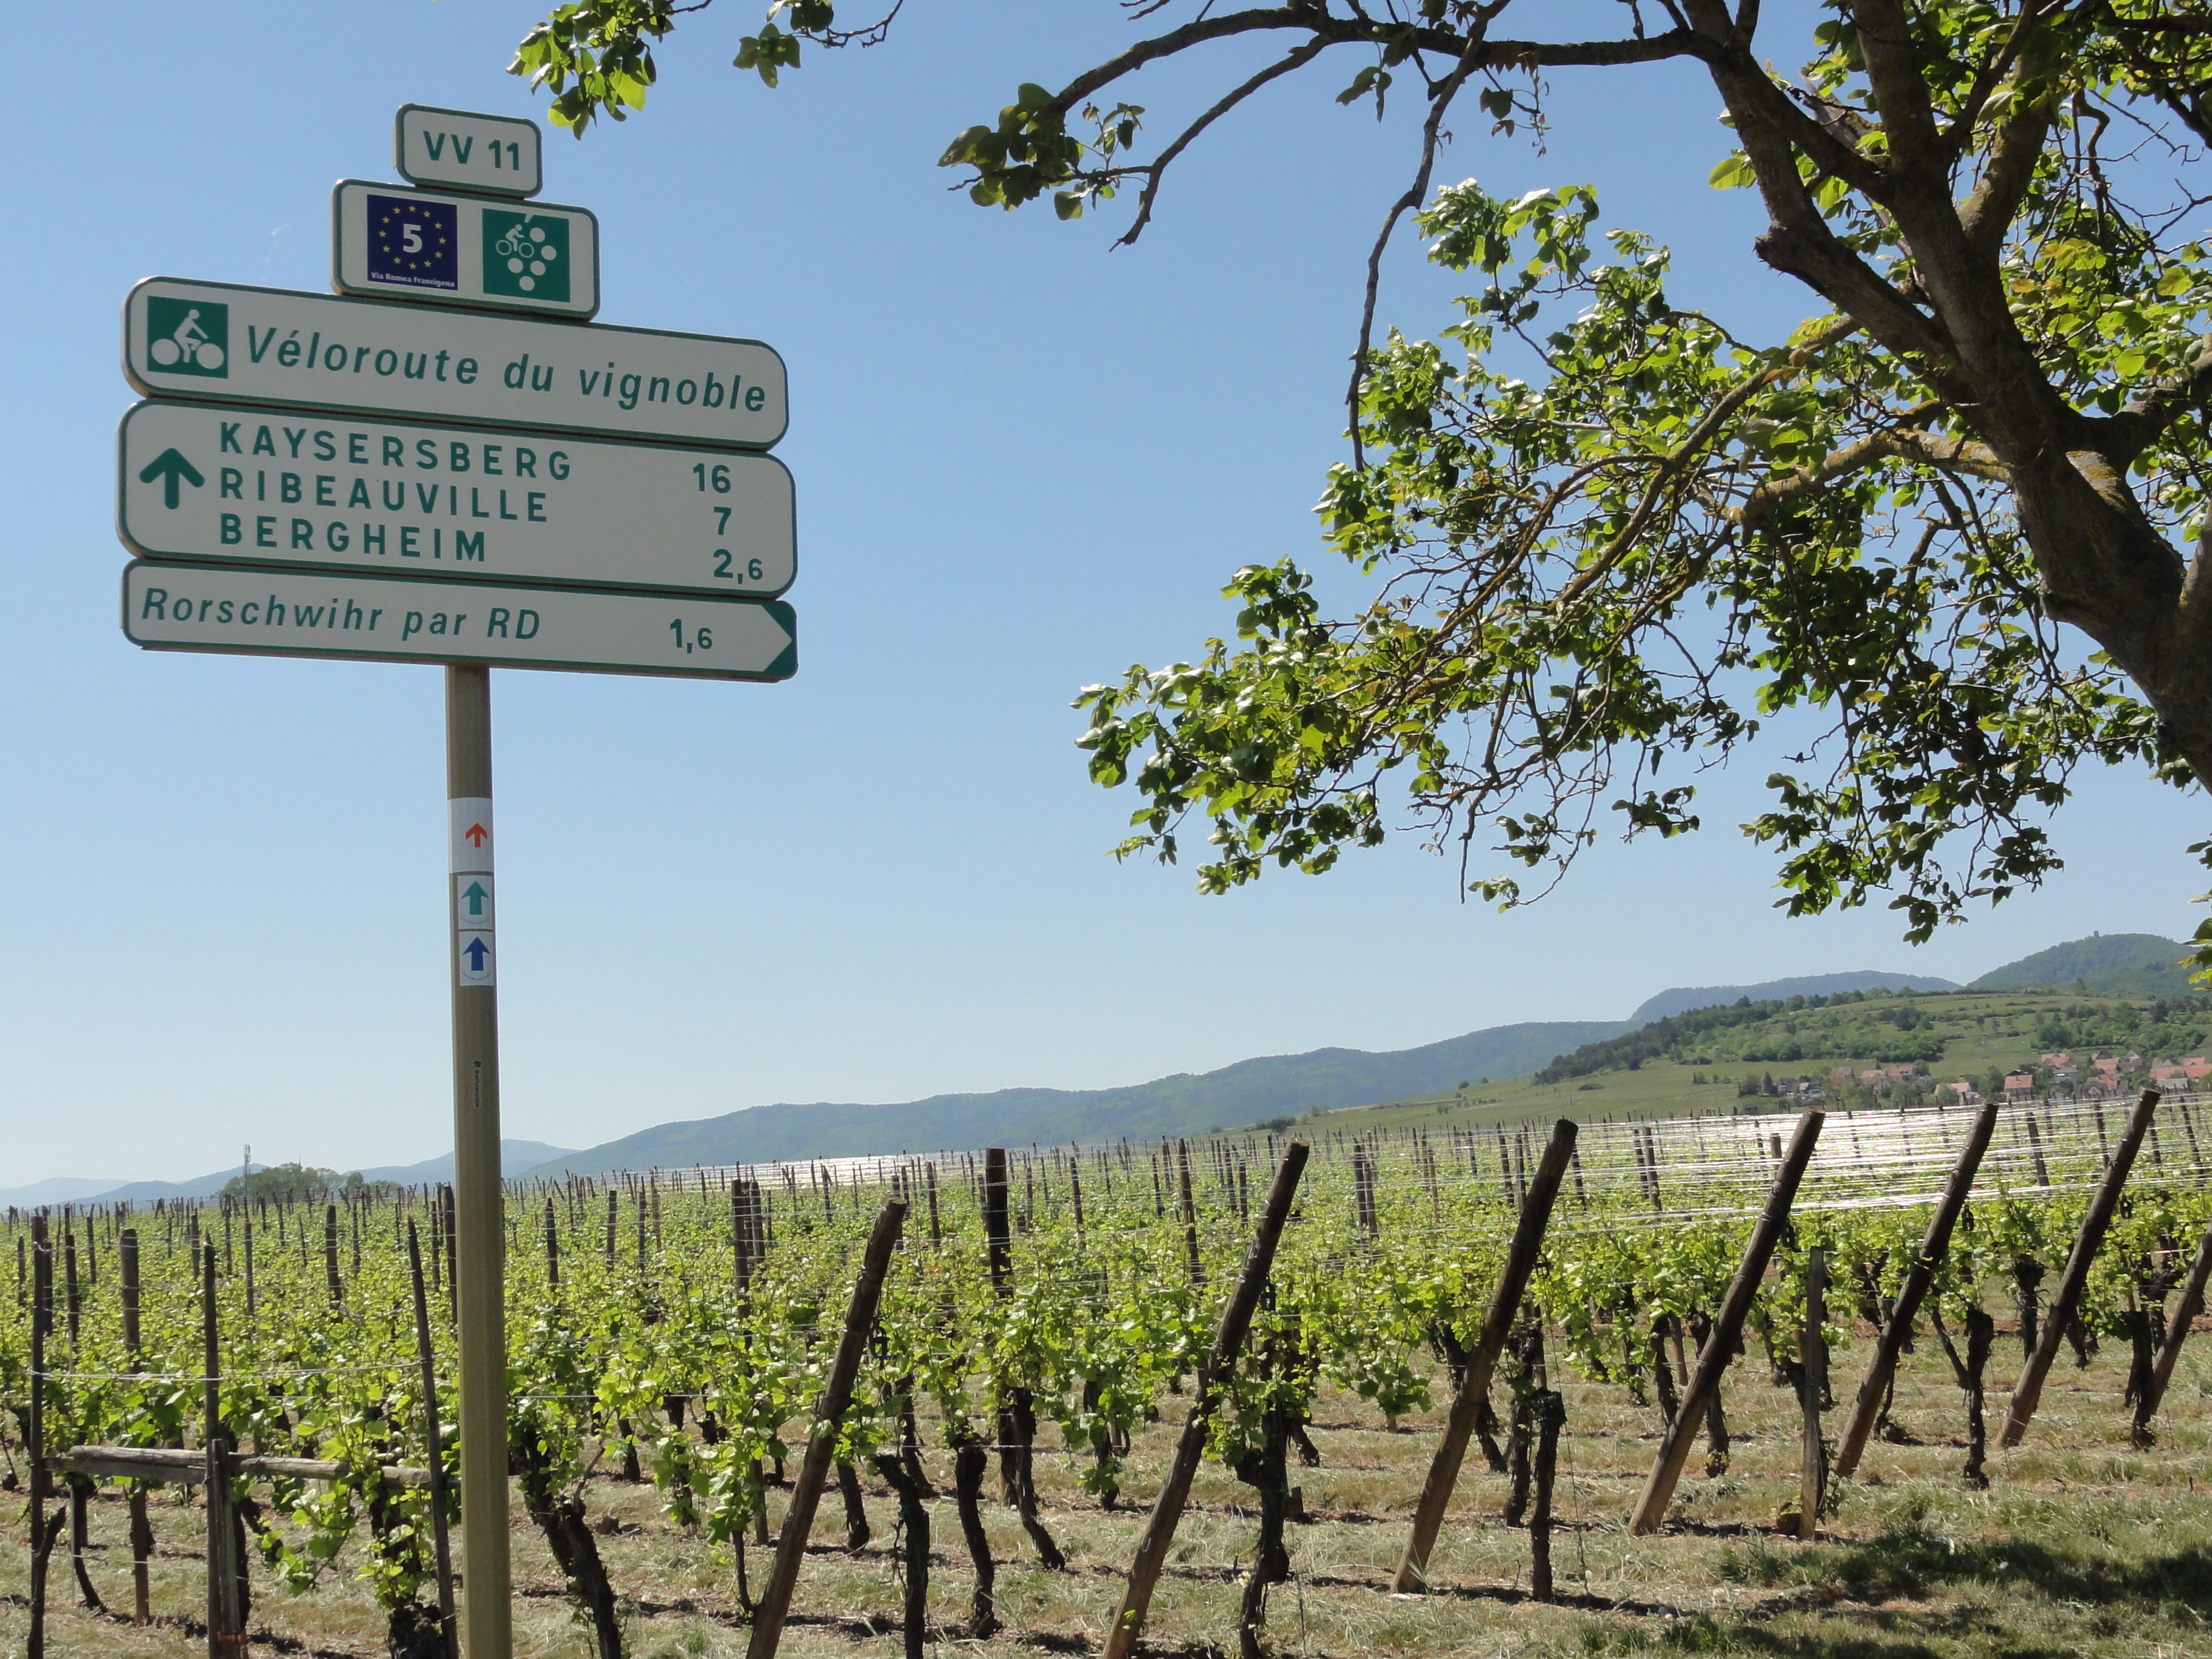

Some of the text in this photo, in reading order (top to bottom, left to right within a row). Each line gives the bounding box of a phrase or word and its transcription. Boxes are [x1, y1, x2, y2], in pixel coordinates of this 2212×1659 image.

[423, 130, 520, 171] VV 11
[403, 223, 423, 253] 5
[385, 273, 412, 283] Romea
[414, 276, 455, 287] Francigena
[248, 325, 766, 412] Véloroute du vignoble
[220, 421, 732, 494] KAYSERSBERG 16
[220, 467, 732, 536] RIBEAUVILLE 7
[220, 513, 763, 585] BERGHEIM 2,6
[141, 587, 713, 654] Rorschwihr par RD 1,6
